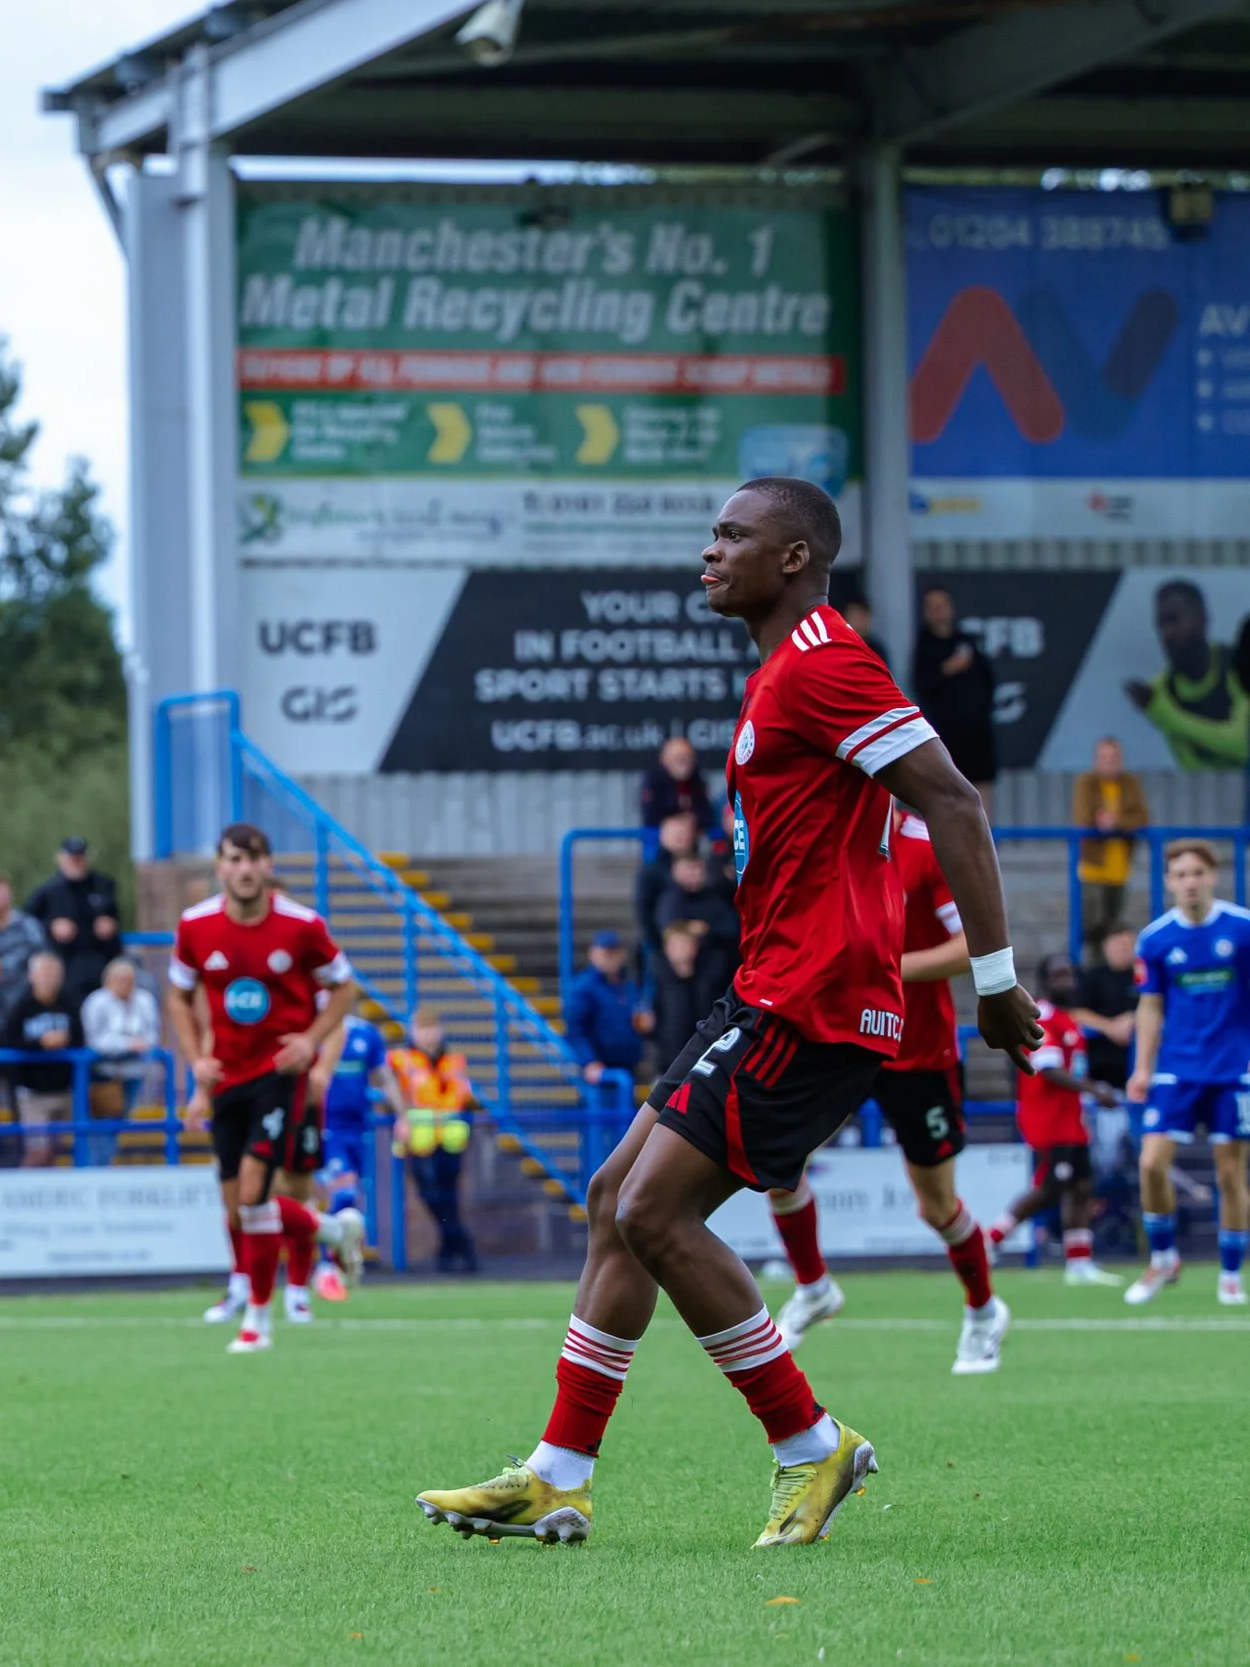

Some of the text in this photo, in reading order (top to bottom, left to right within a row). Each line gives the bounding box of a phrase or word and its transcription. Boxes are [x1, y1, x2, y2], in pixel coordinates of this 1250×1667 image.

[295, 216, 775, 277] Manchester's No. 1
[242, 274, 831, 344] Metal Recycling Centre
[581, 590, 680, 623] YOUR
[258, 618, 377, 656] UCFB
[514, 629, 554, 662] IN
[560, 629, 739, 662] FOOTBALL
[474, 668, 592, 701] SPORT
[598, 668, 727, 701] STARTS
[280, 686, 358, 722] GIS
[691, 1026, 742, 1077] 2
[925, 1106, 949, 1139] 5
